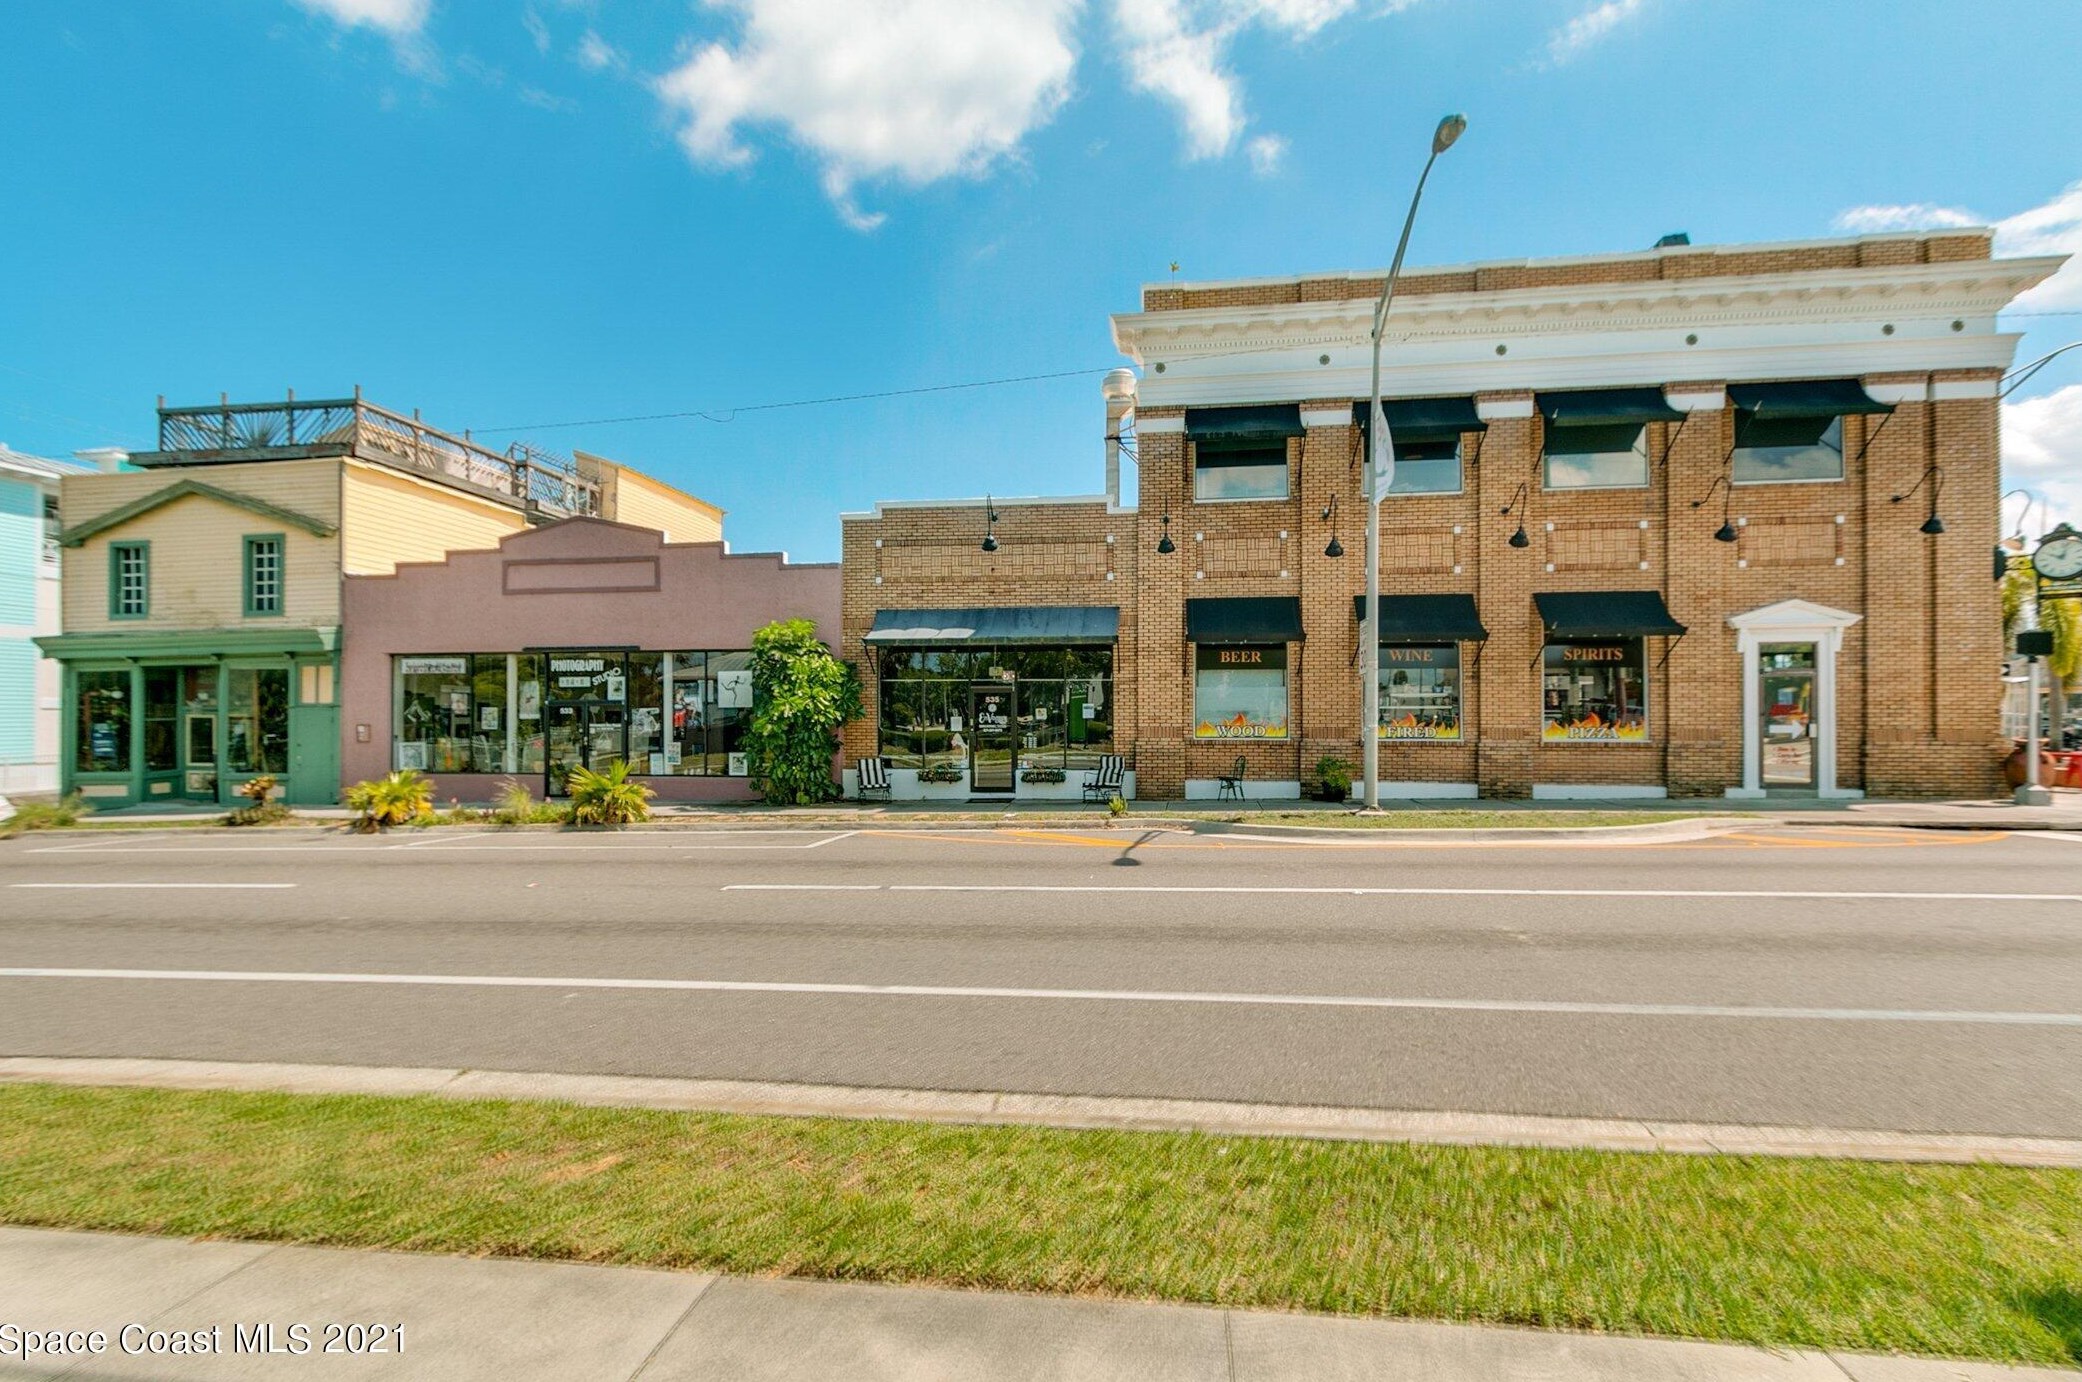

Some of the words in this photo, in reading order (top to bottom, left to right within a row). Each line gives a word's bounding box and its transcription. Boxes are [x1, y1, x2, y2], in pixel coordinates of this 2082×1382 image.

[1220, 651, 1262, 663] BEER
[1389, 649, 1433, 662] WINE
[1563, 647, 1623, 660] SPIRITS
[551, 659, 605, 672] PHOTOGRAPHY
[592, 667, 622, 686] STUDIO
[1215, 725, 1266, 738] WOOD
[1386, 726, 1436, 738] FIRED
[1568, 727, 1620, 739] PIZZA
